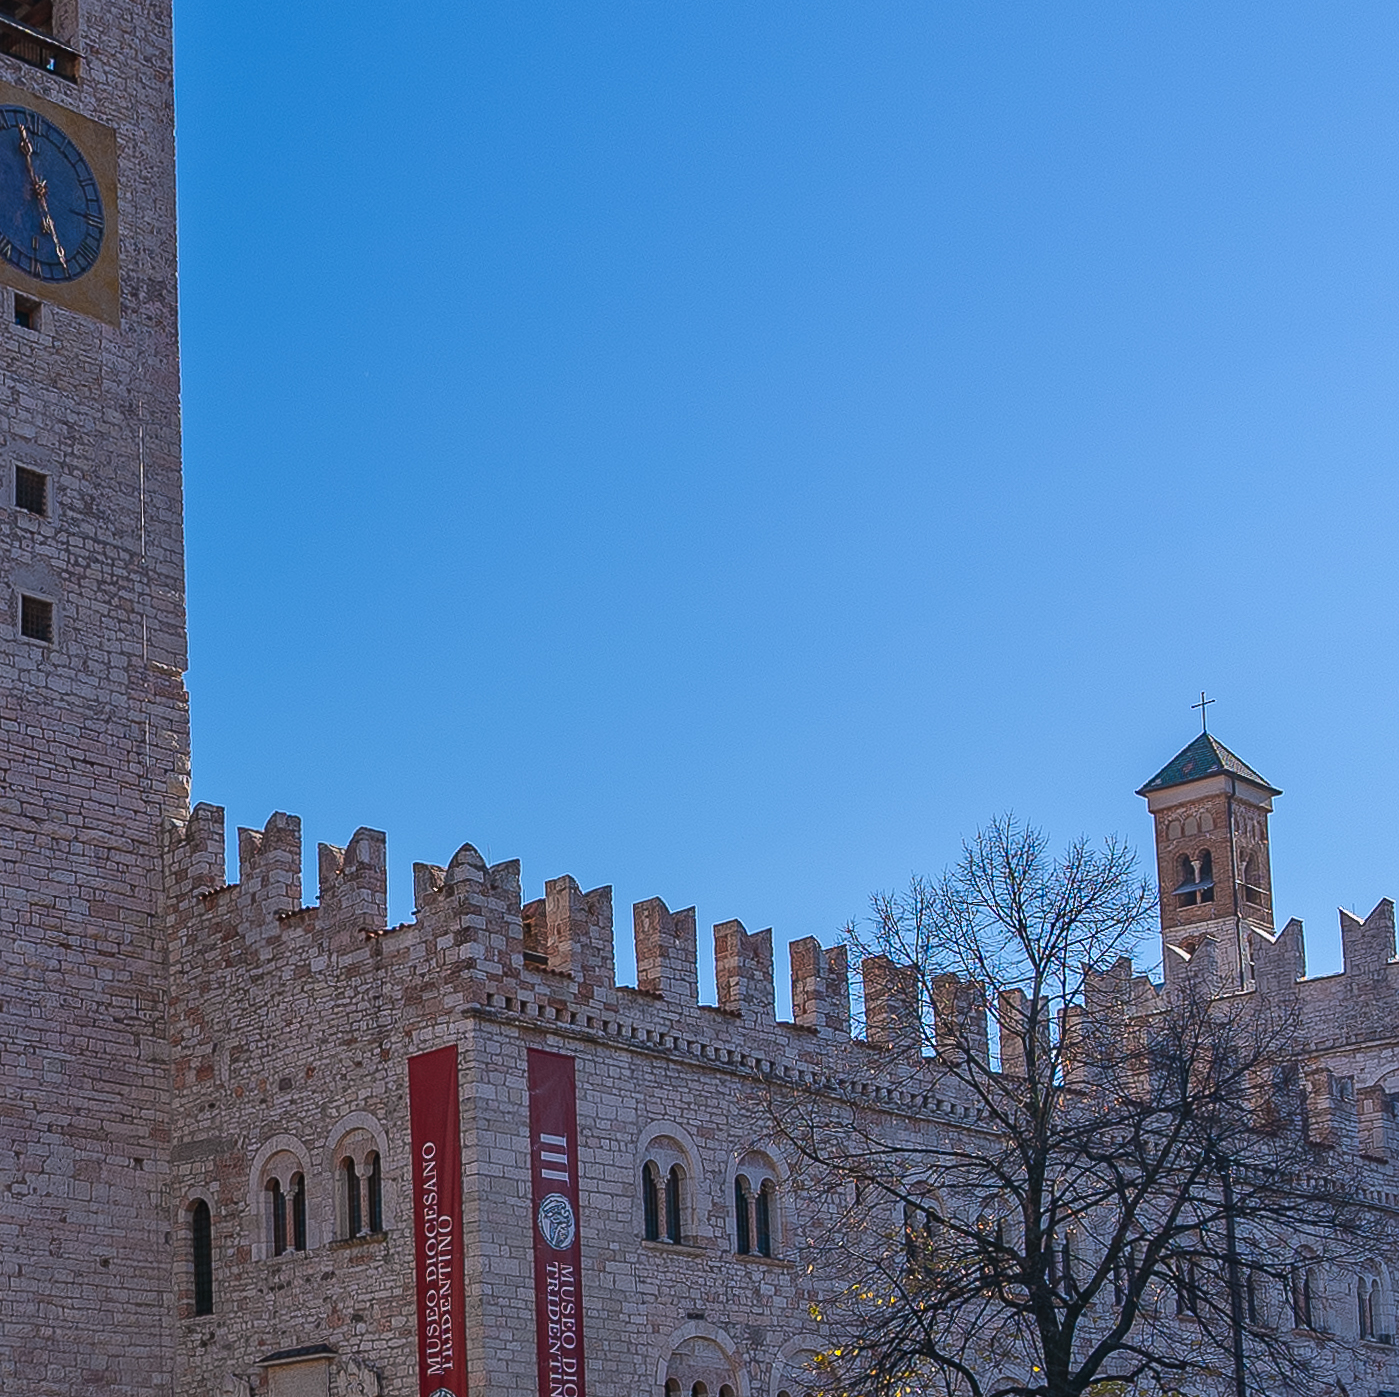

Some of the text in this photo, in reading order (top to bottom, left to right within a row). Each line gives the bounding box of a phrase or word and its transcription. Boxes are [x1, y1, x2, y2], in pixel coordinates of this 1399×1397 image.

[422, 1141, 445, 1377] MUSEO DIOCESANO
[437, 1215, 455, 1370] TRIDENTINO
[560, 1262, 577, 1349] MUSEO
